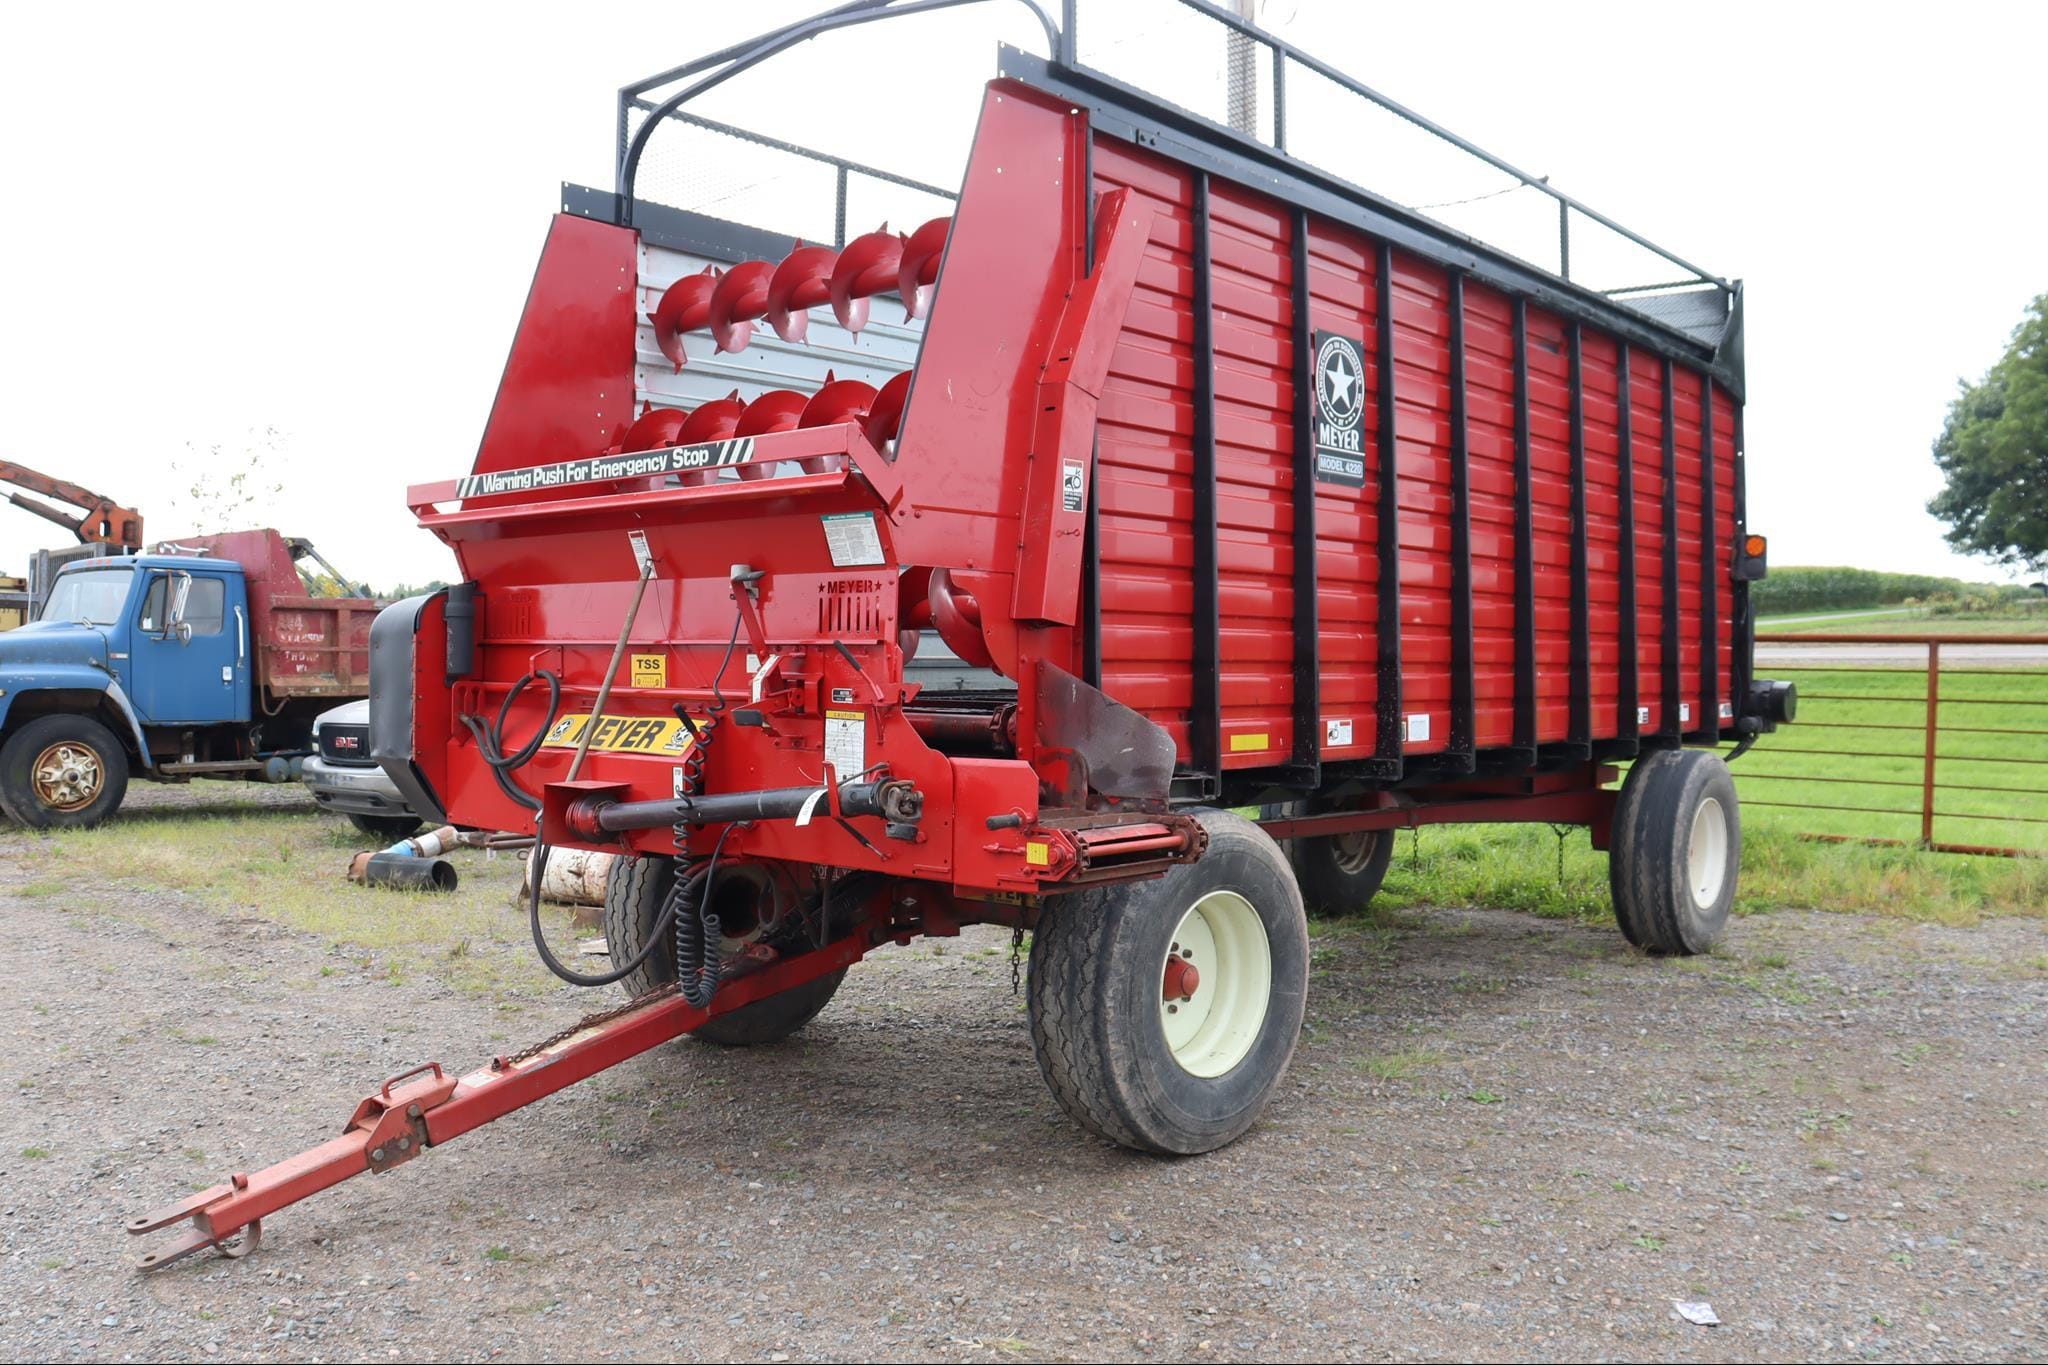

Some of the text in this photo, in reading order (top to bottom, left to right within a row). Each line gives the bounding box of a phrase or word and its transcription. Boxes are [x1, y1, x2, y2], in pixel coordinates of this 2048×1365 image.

[1320, 422, 1359, 451] MEYER
[482, 448, 709, 493] Warning Push For Emergency Stop
[1320, 457, 1344, 471] MODEL
[827, 580, 873, 594] MEYER
[636, 659, 660, 670] TSS
